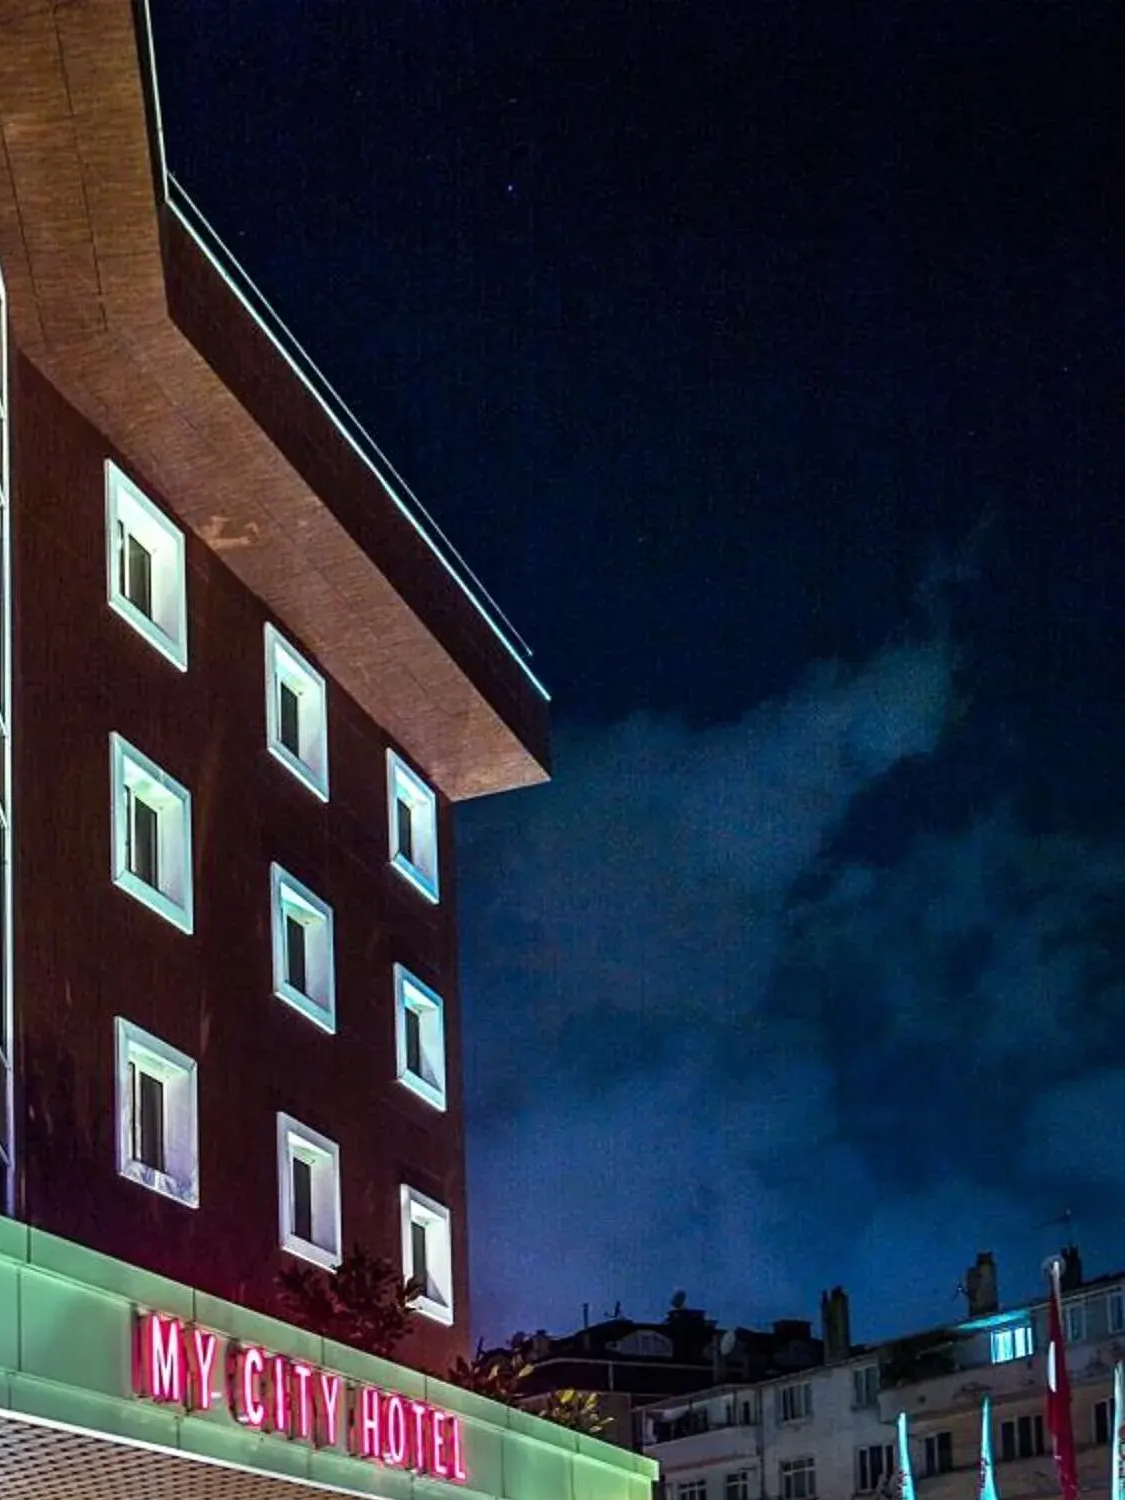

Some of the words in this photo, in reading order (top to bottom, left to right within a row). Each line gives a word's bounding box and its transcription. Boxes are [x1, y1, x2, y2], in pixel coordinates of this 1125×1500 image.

[143, 1309, 218, 1411] MY
[236, 1344, 341, 1445] CITY
[357, 1385, 467, 1484] HOTEL
